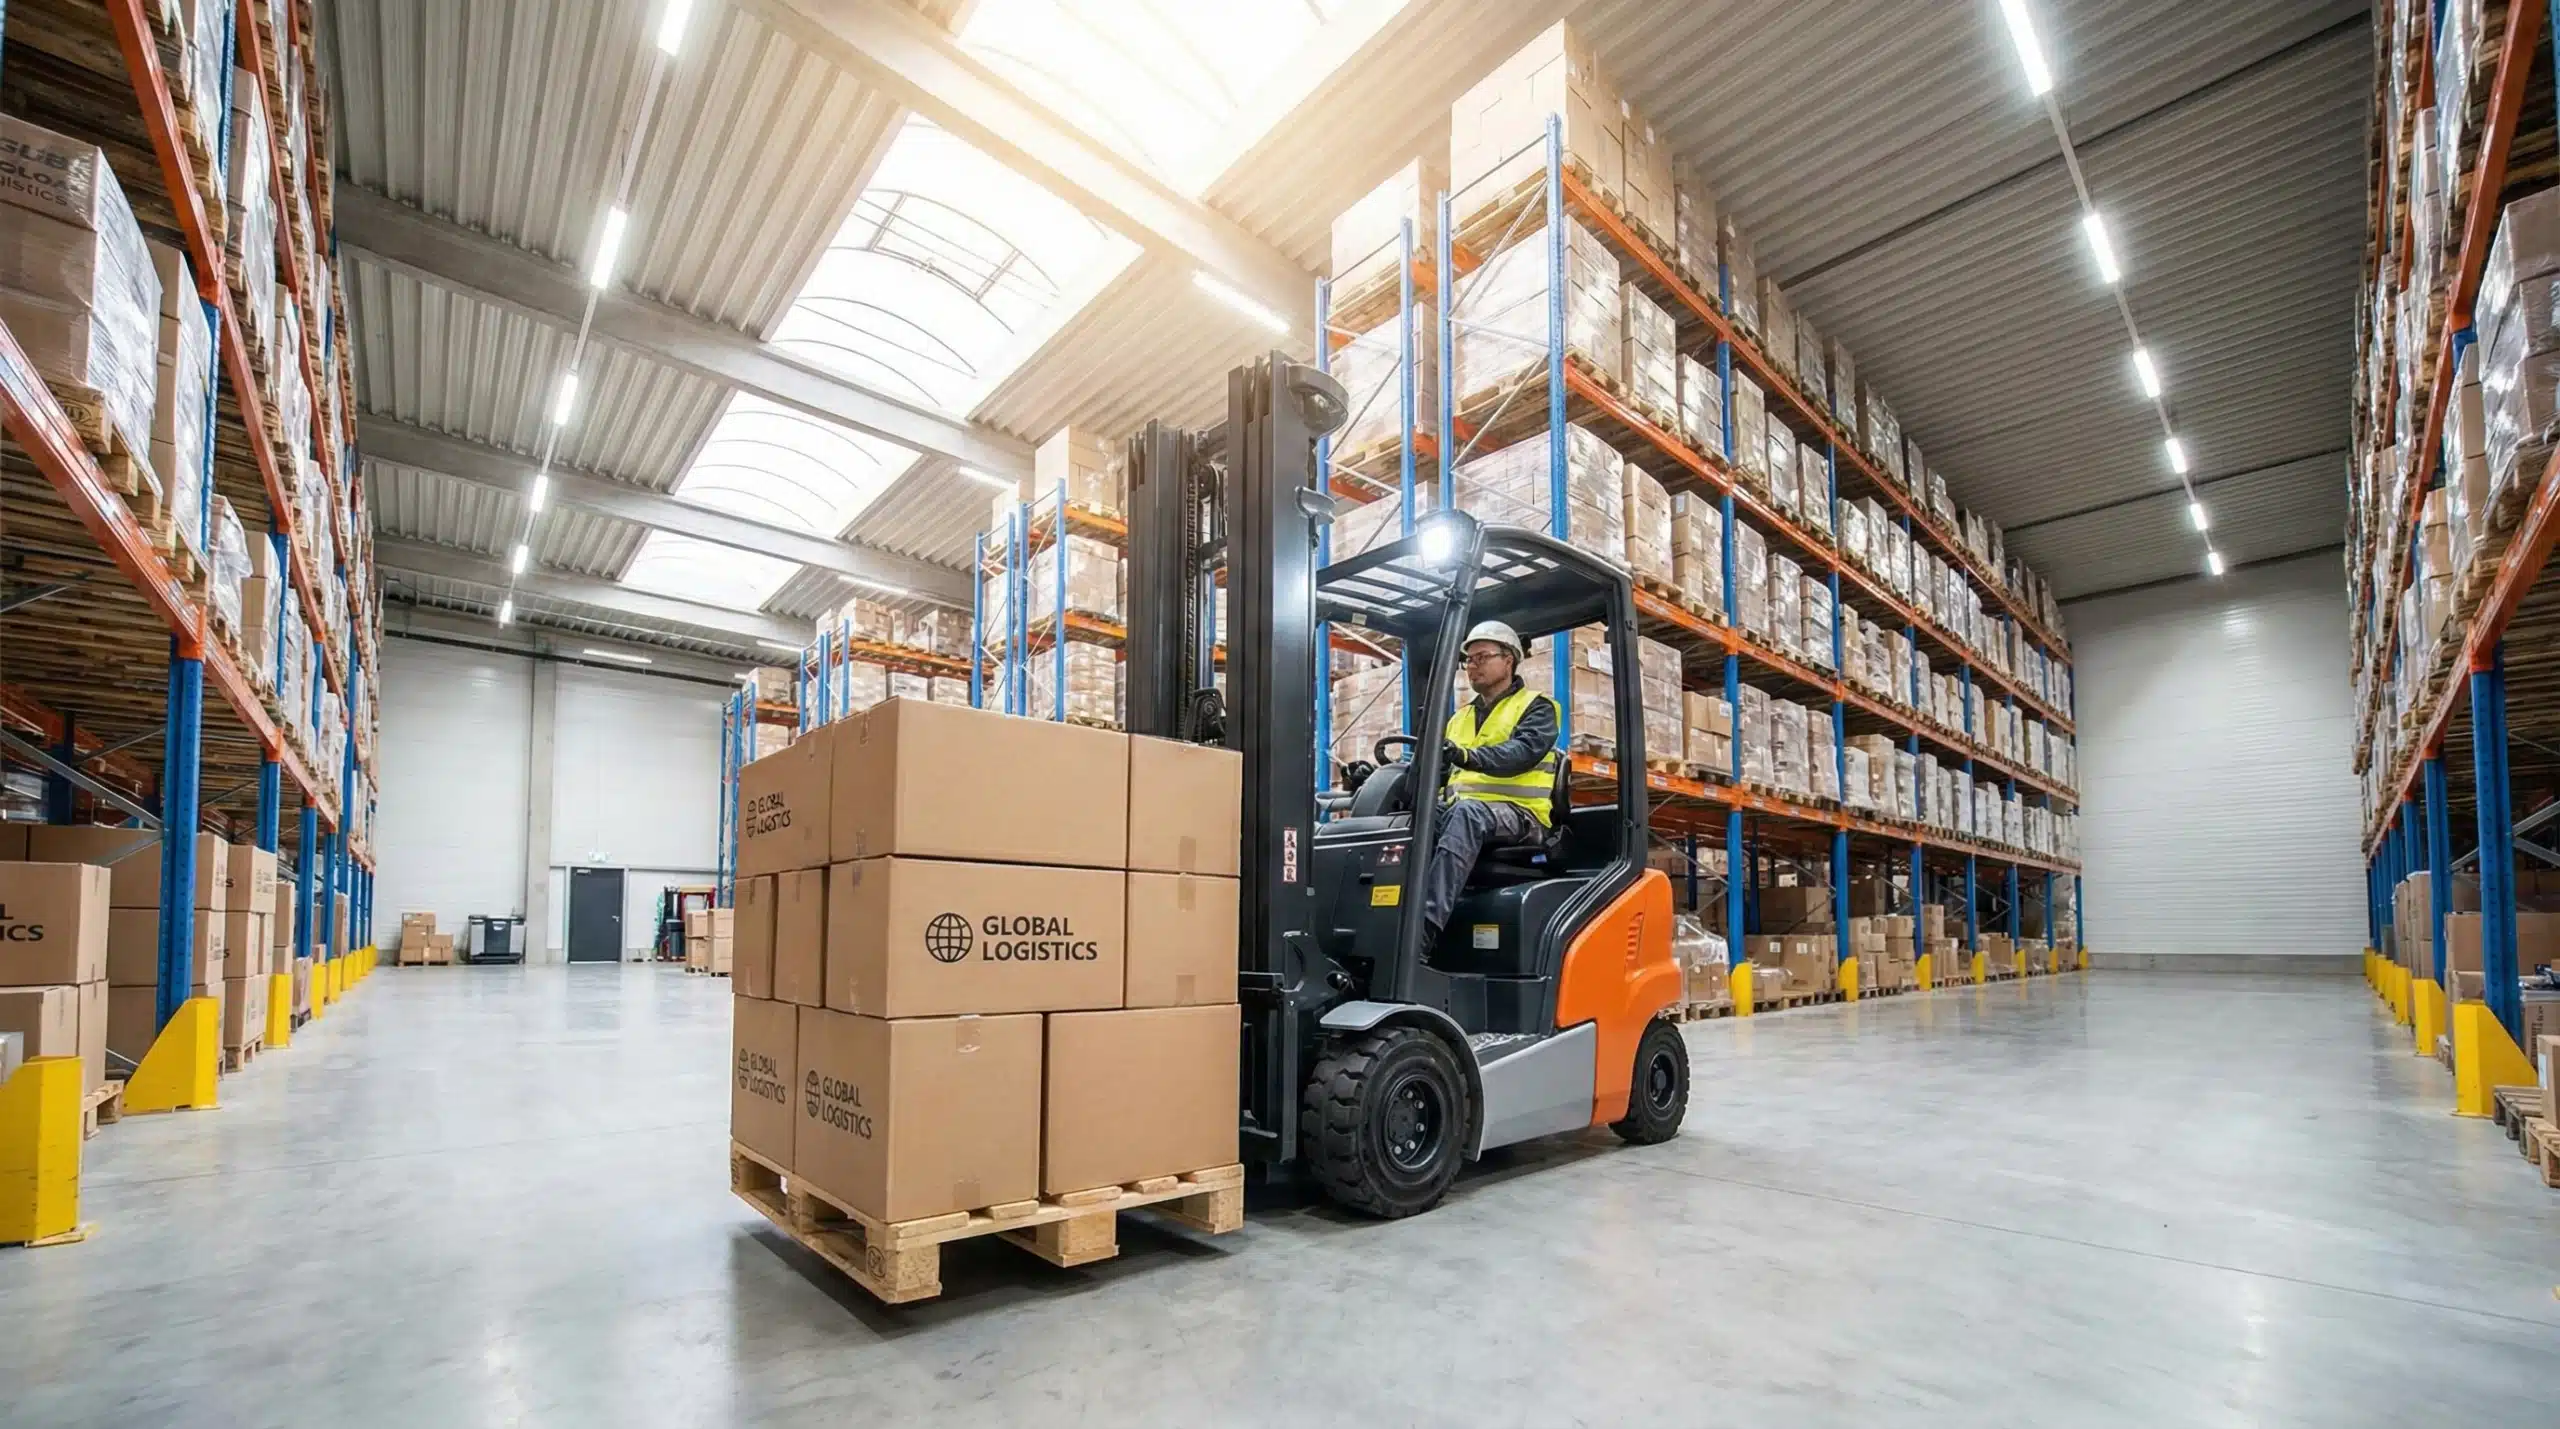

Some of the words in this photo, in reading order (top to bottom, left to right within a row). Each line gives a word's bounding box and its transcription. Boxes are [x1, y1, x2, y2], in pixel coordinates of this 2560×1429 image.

[982, 916, 1074, 937] GLOBAL
[982, 941, 1098, 961] LOGISTICS
[822, 1075, 862, 1108] GLOBAL
[822, 1099, 872, 1140] LOGISTICS
